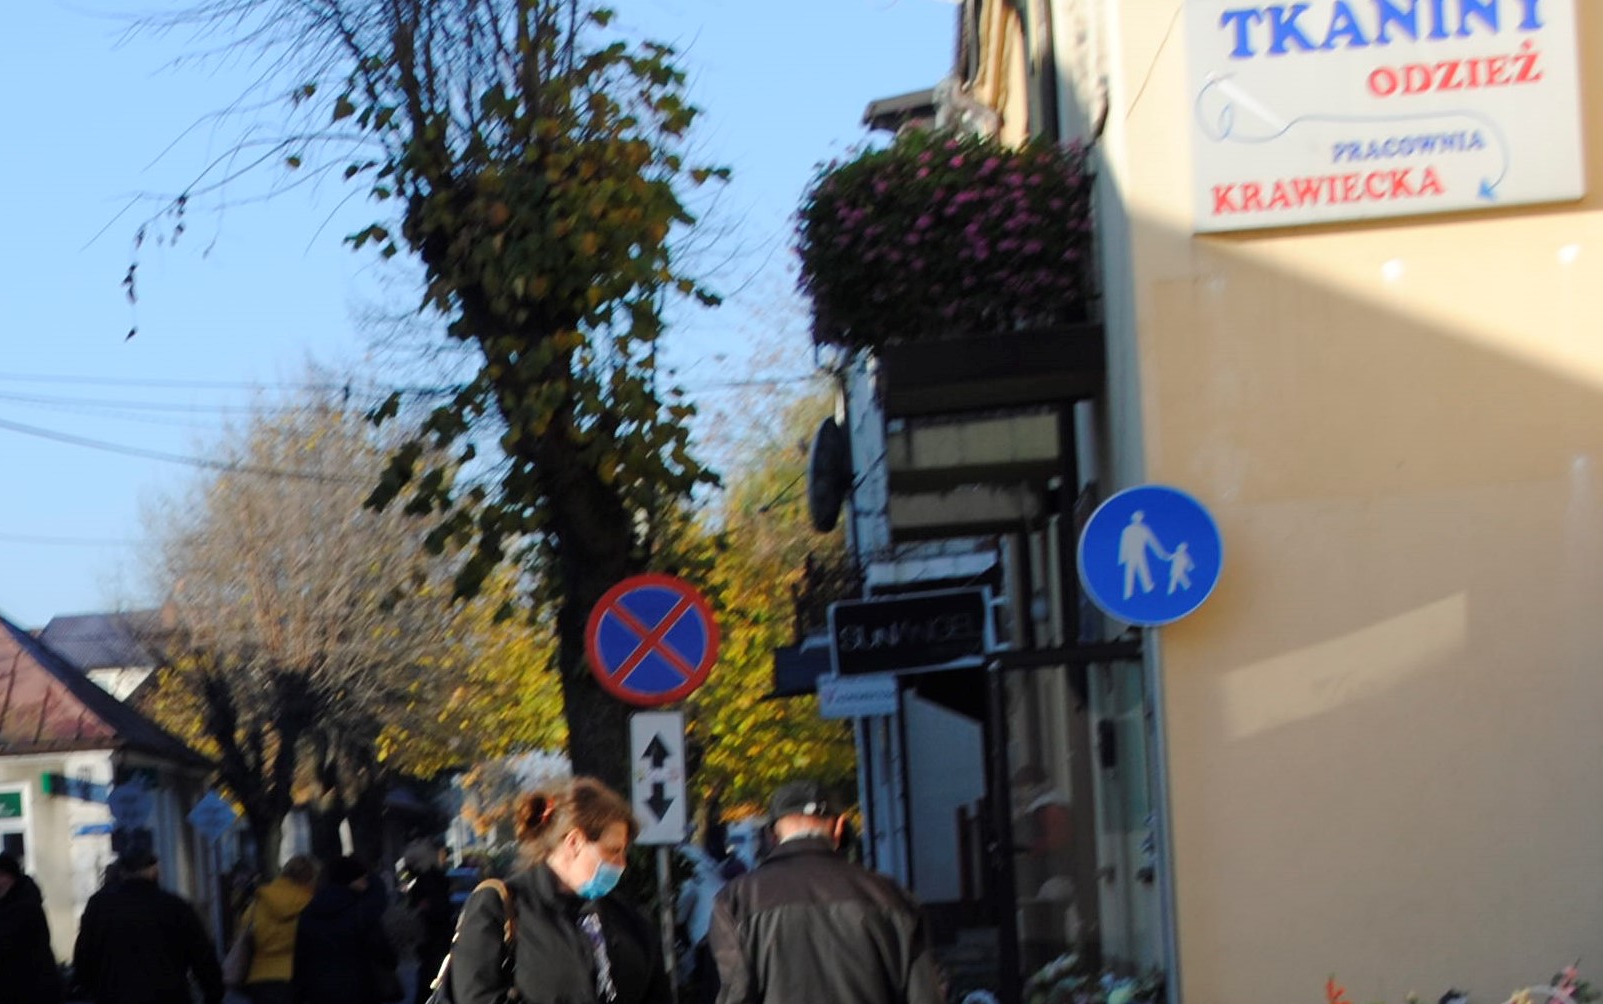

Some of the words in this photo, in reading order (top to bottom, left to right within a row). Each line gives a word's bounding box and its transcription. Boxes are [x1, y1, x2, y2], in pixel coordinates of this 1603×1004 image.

[1366, 40, 1545, 98] ODZIEŻ
[1332, 129, 1487, 163] PRACOWNIA
[1210, 165, 1445, 216] KRAWIECKA
